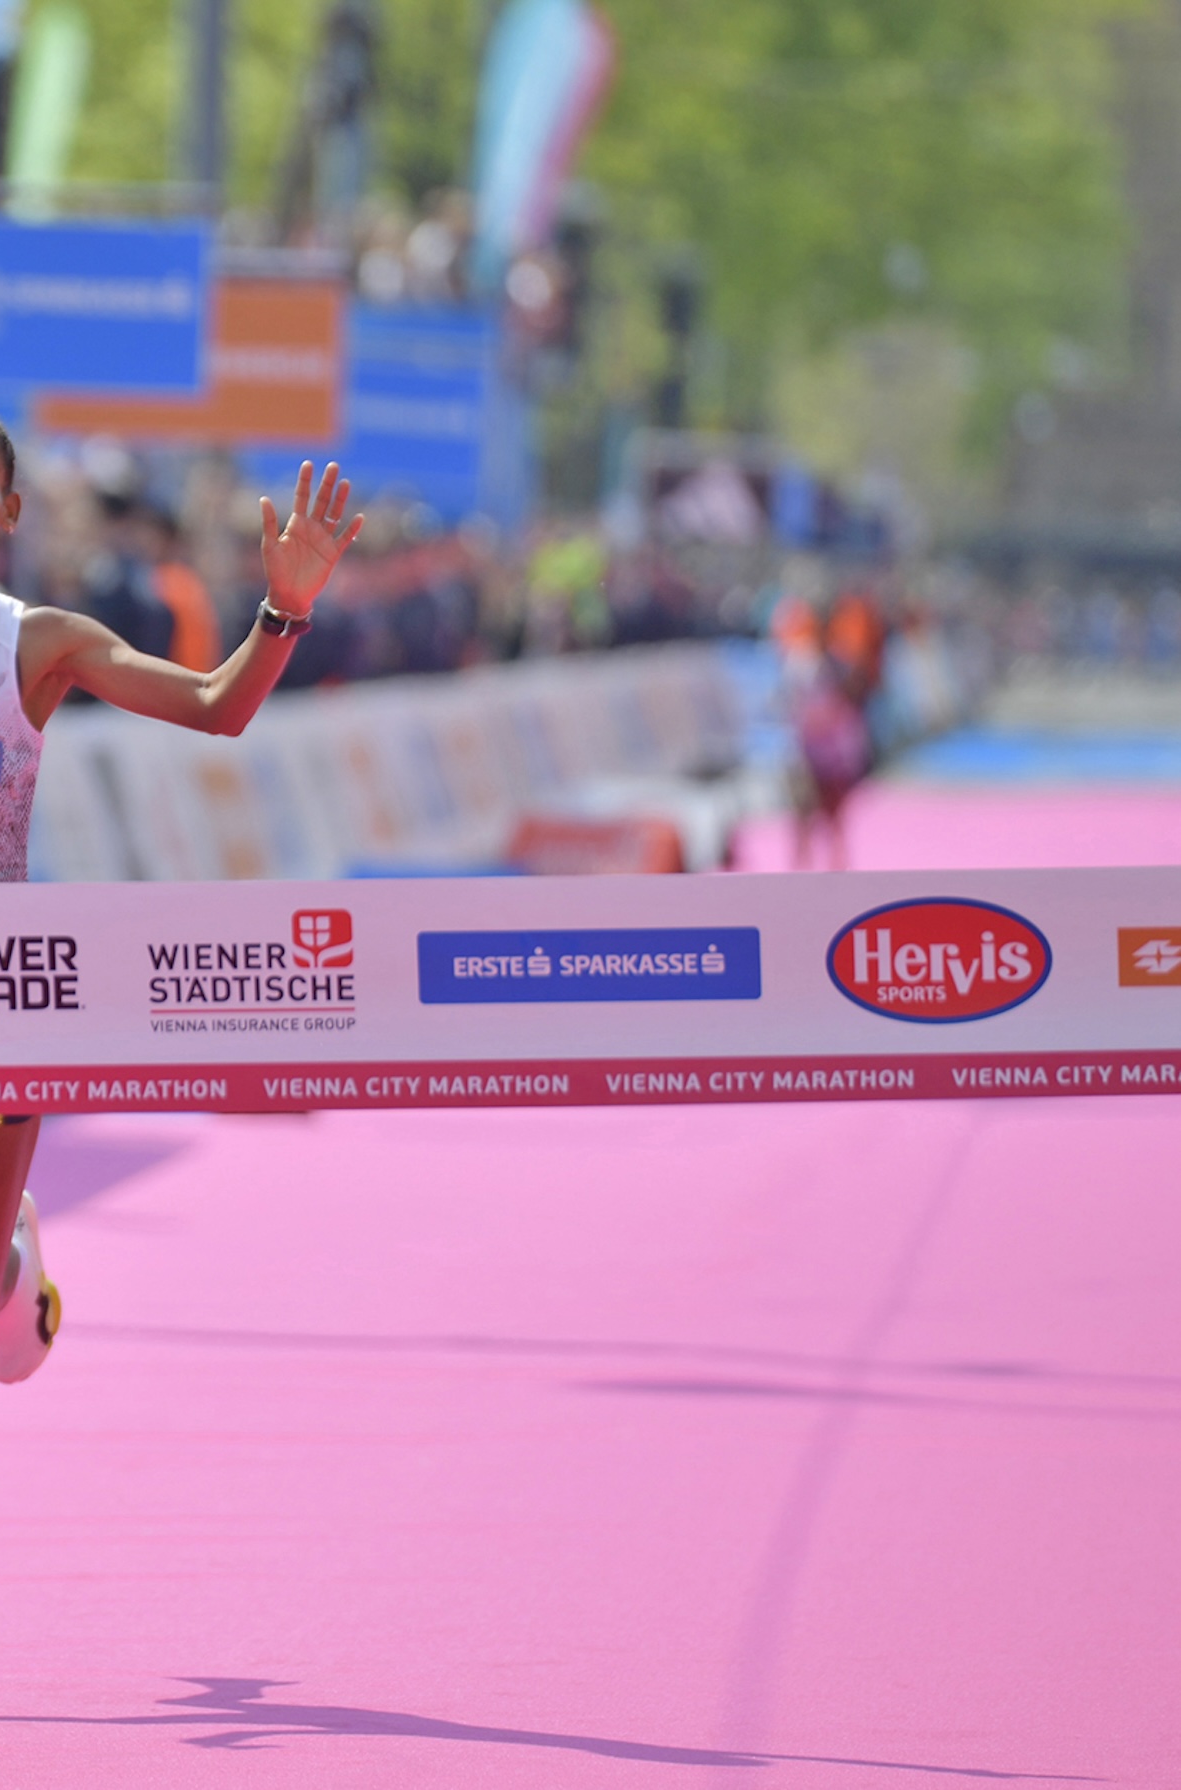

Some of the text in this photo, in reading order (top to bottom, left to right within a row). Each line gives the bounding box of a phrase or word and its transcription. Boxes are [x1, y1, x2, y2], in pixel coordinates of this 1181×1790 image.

[148, 944, 286, 970] WIENER
[453, 953, 697, 978] ERSTE SPARKASSE
[852, 928, 1032, 996] Hervis
[149, 975, 355, 1003] STÄDTISCHE
[877, 985, 946, 1003] SPORTS
[150, 1017, 356, 1033] VIENNA INSURANCE GROUP
[264, 1075, 569, 1098] VIENNA CITY MARATHON
[606, 1069, 914, 1093] VIENNA CITY MARATHON
[952, 1064, 1181, 1087] VIENNA CITY MAR
[25, 1080, 81, 1100] CITY
[88, 1079, 226, 1099] MARATHON
